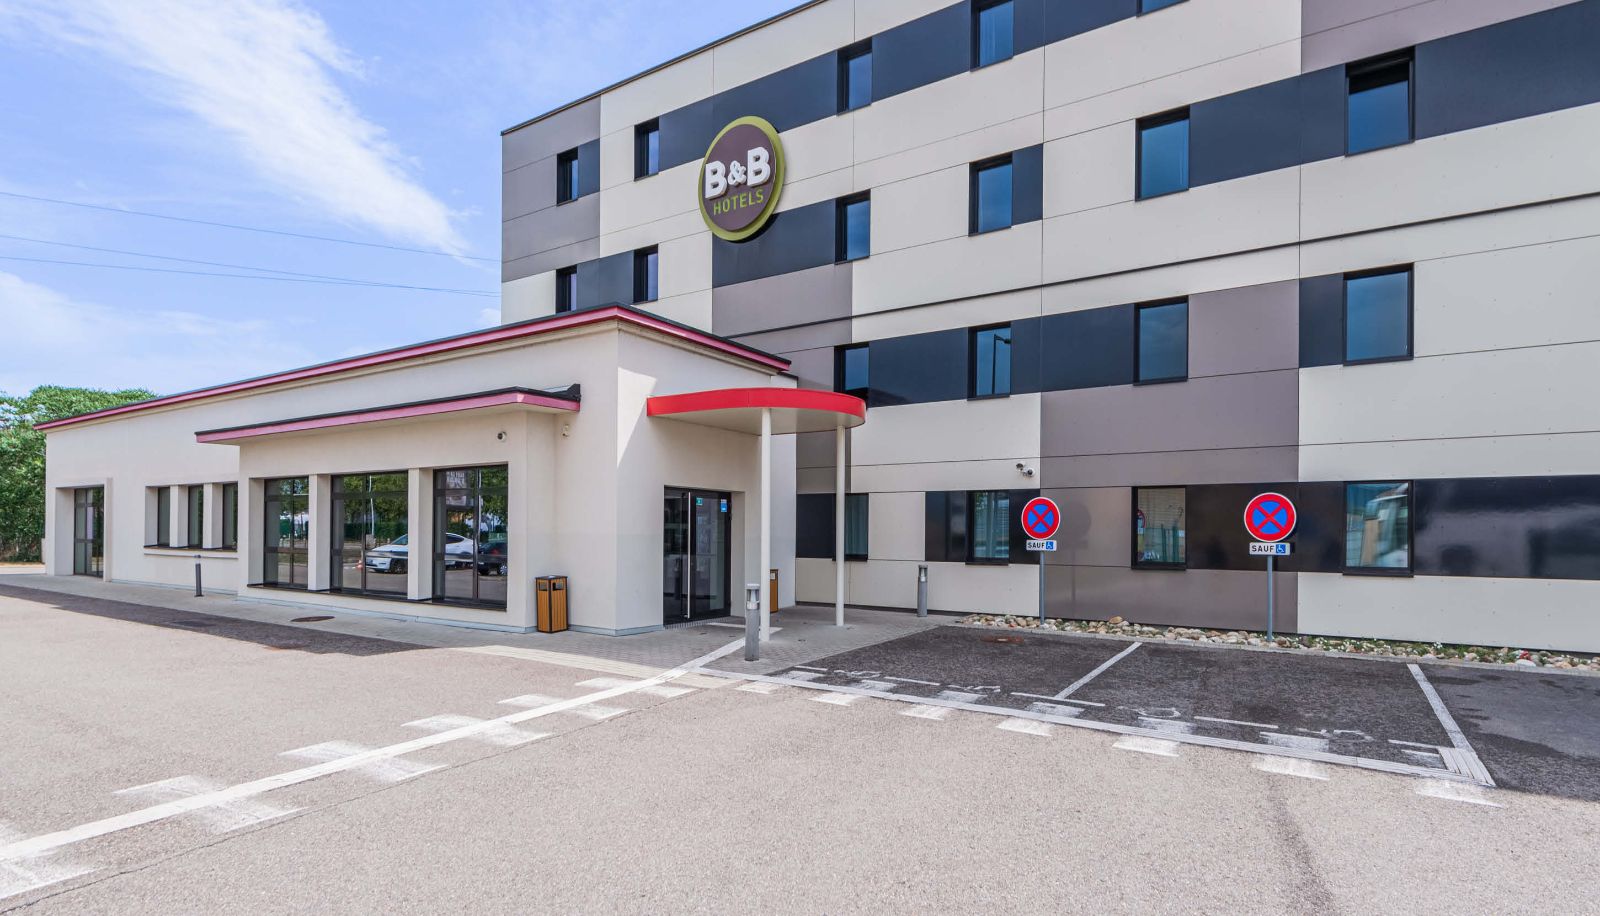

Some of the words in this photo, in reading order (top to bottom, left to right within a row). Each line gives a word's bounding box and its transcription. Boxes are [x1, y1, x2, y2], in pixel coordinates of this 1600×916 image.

[705, 146, 771, 199] B&B
[713, 188, 765, 216] HOTELS
[1251, 545, 1275, 553] SAUF
